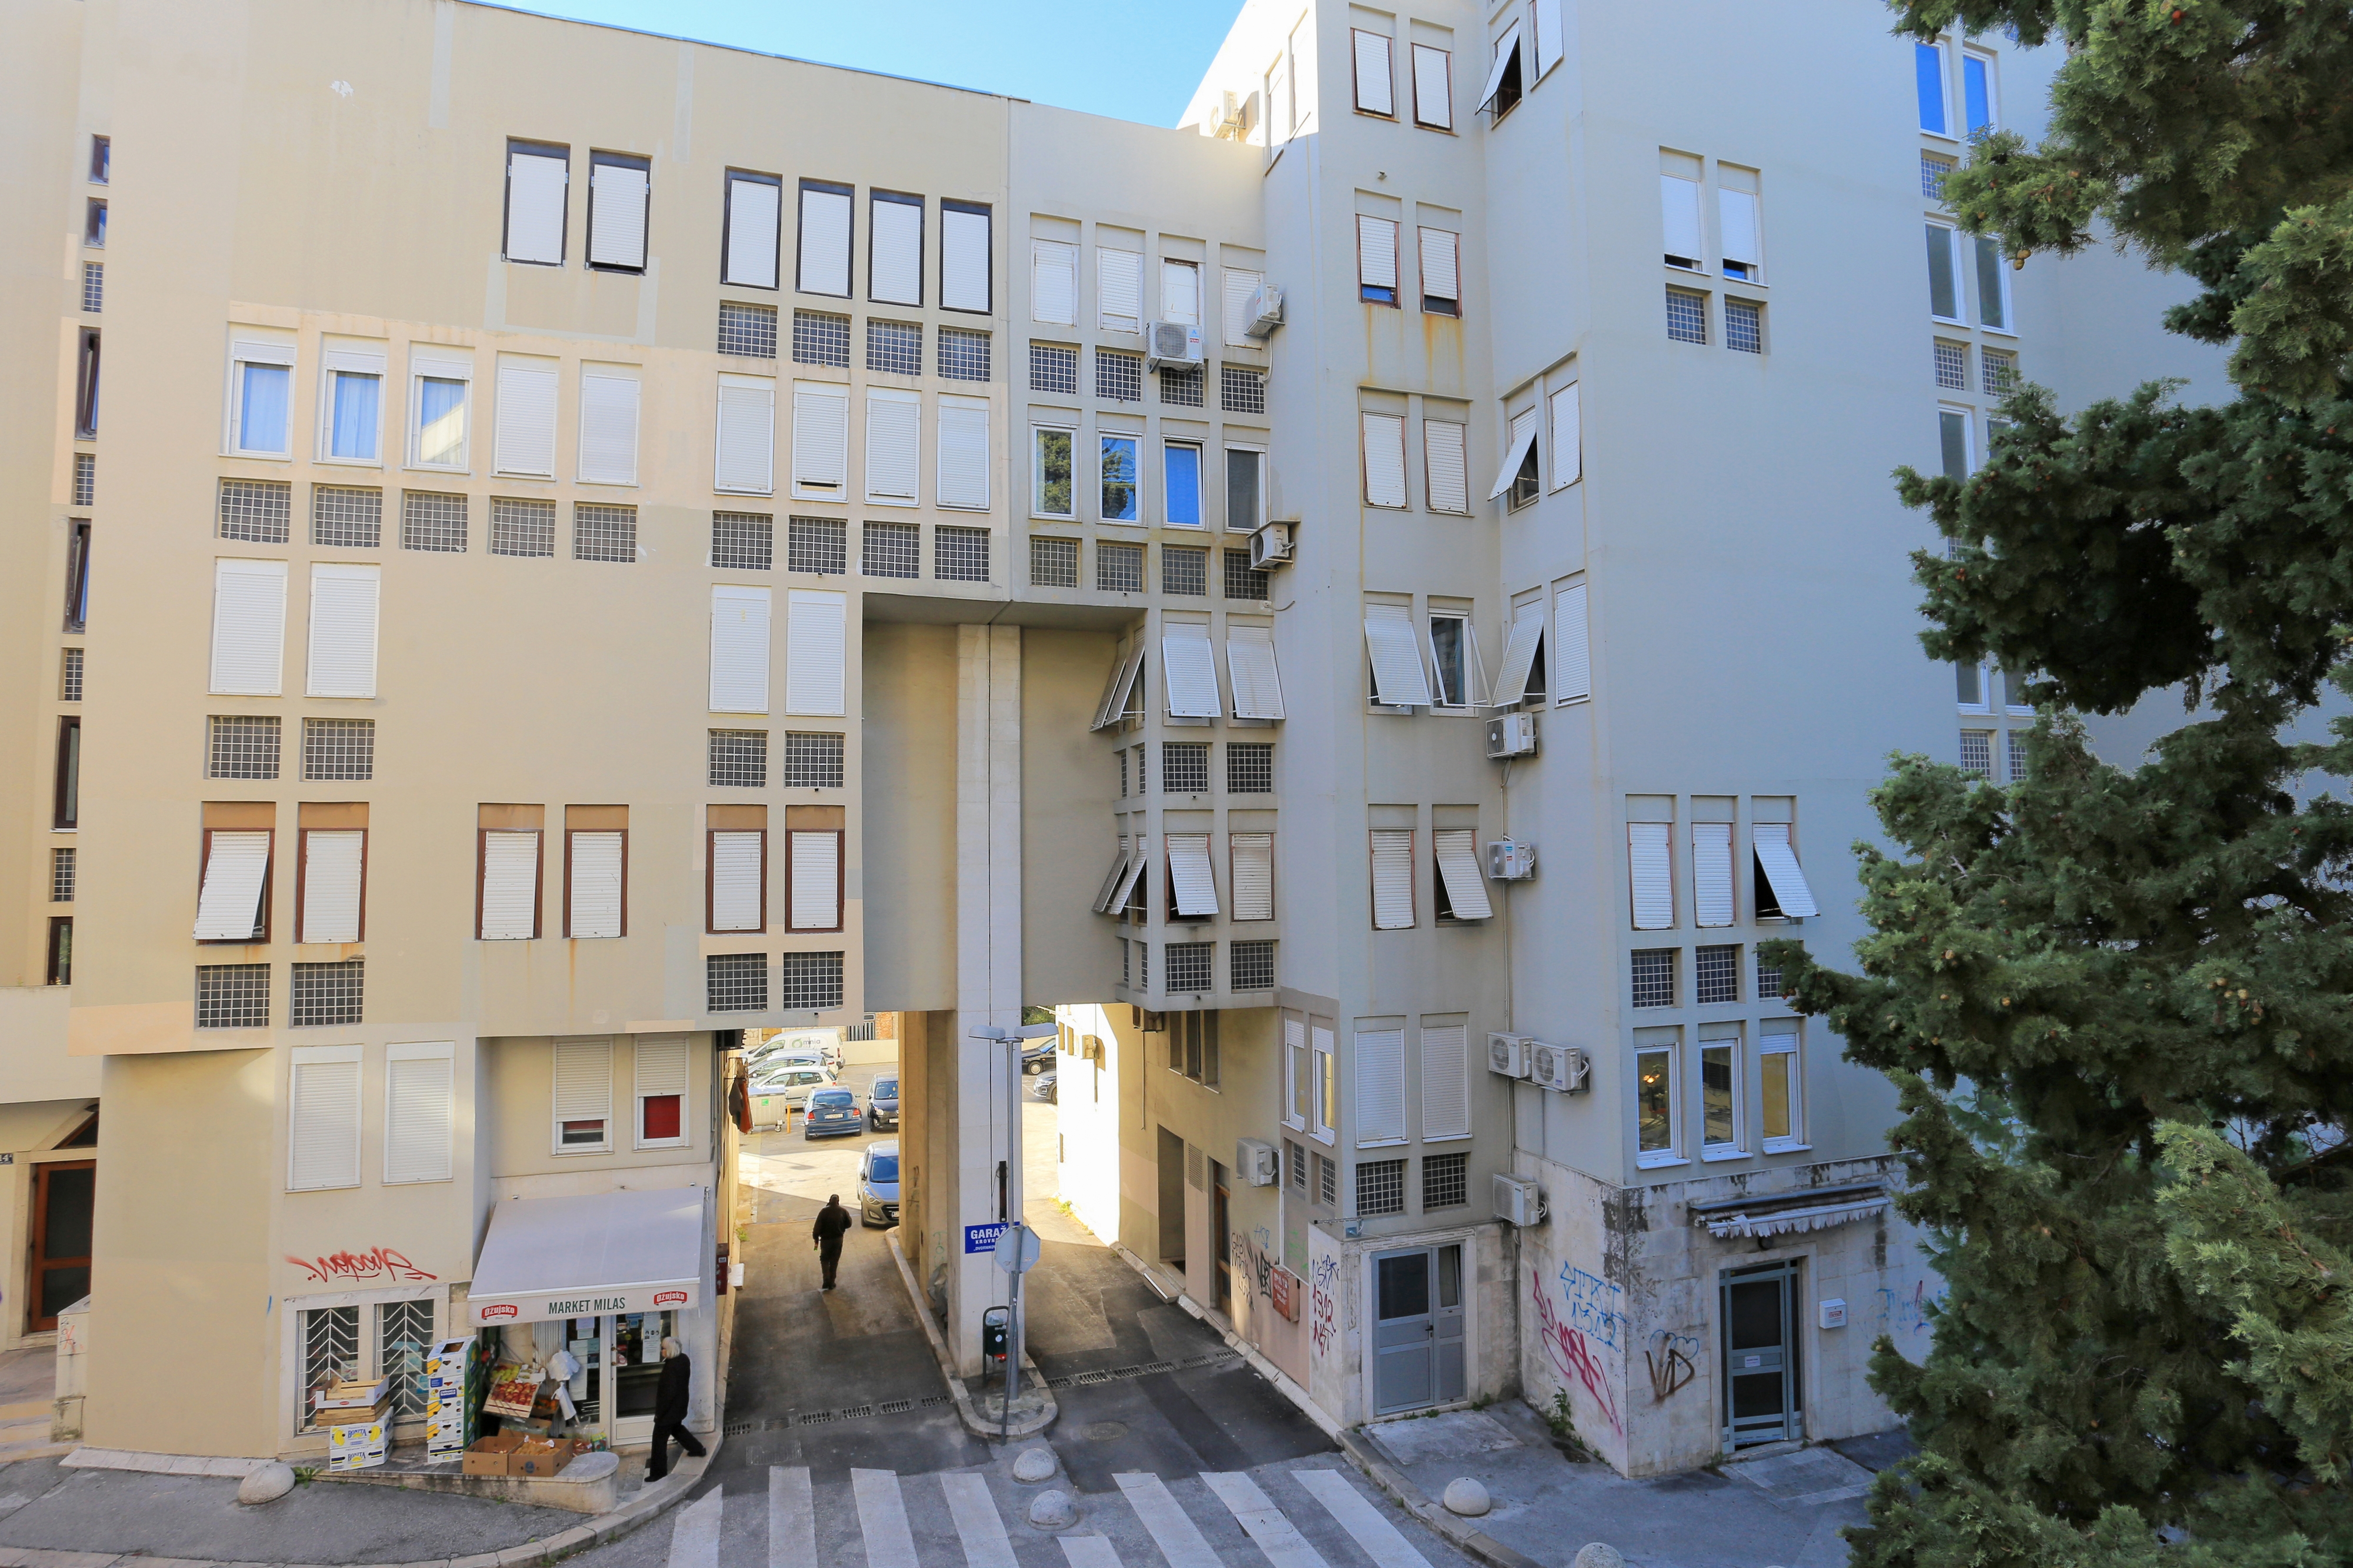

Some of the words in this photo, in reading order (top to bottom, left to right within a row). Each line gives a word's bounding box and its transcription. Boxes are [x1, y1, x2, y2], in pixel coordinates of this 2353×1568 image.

[656, 1292, 685, 1303] Ožujsko
[484, 1305, 515, 1317] Ožujsko
[548, 1300, 591, 1315] MARKET
[594, 1297, 625, 1310] MILAS
